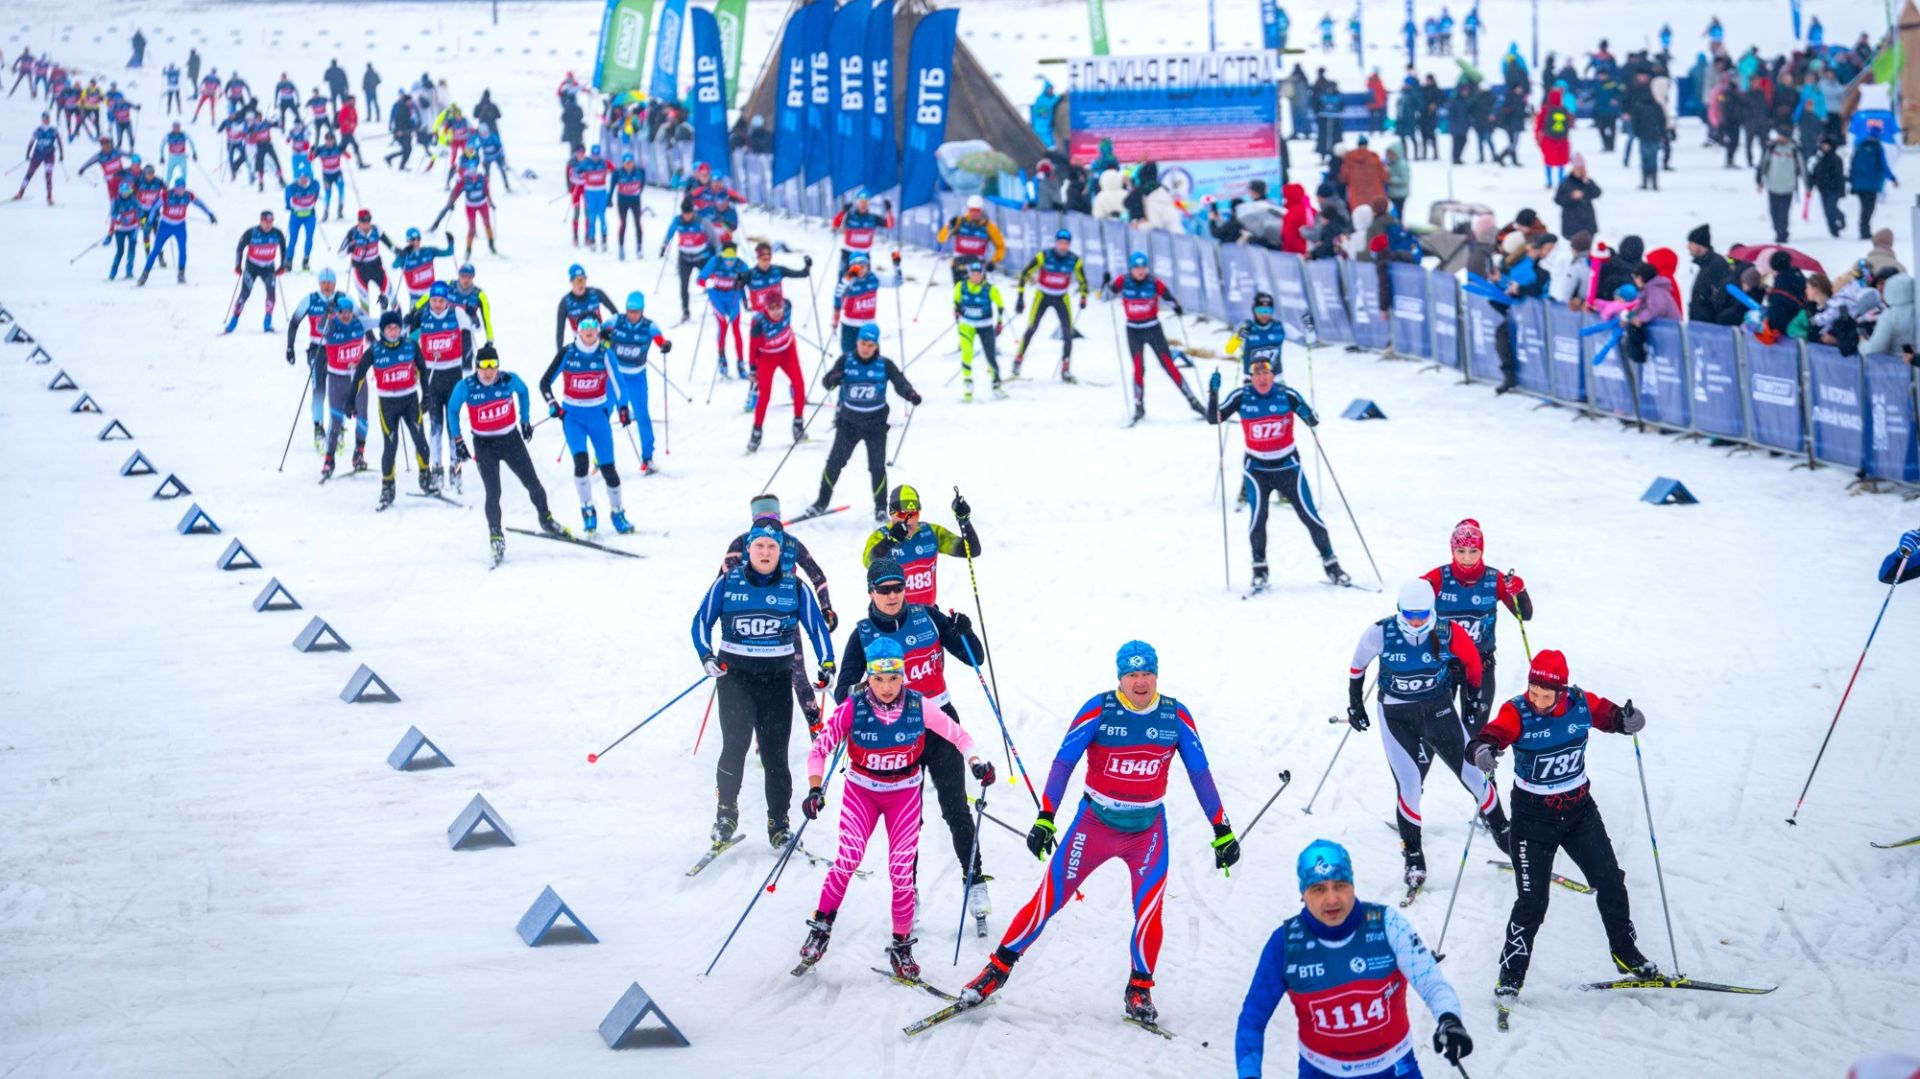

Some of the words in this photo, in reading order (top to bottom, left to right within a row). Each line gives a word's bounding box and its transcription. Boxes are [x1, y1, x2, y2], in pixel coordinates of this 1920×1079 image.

[811, 51, 829, 104] ВТБ
[840, 55, 863, 111] ВТБ
[872, 58, 888, 114] ВТБ
[917, 67, 945, 125] ВТБ
[850, 386, 876, 399] 673
[480, 403, 509, 420] 1110
[1252, 421, 1282, 440] 972
[731, 593, 749, 602] ВТБ
[1441, 592, 1458, 602] ВТБ
[735, 618, 781, 637] 502
[1106, 726, 1128, 737] ВТБ
[1108, 758, 1161, 776] 1540
[1538, 749, 1582, 779] 732
[1066, 832, 1087, 880] RUSSIA
[1298, 963, 1326, 979] ВТБ
[1314, 997, 1385, 1030] 1114
